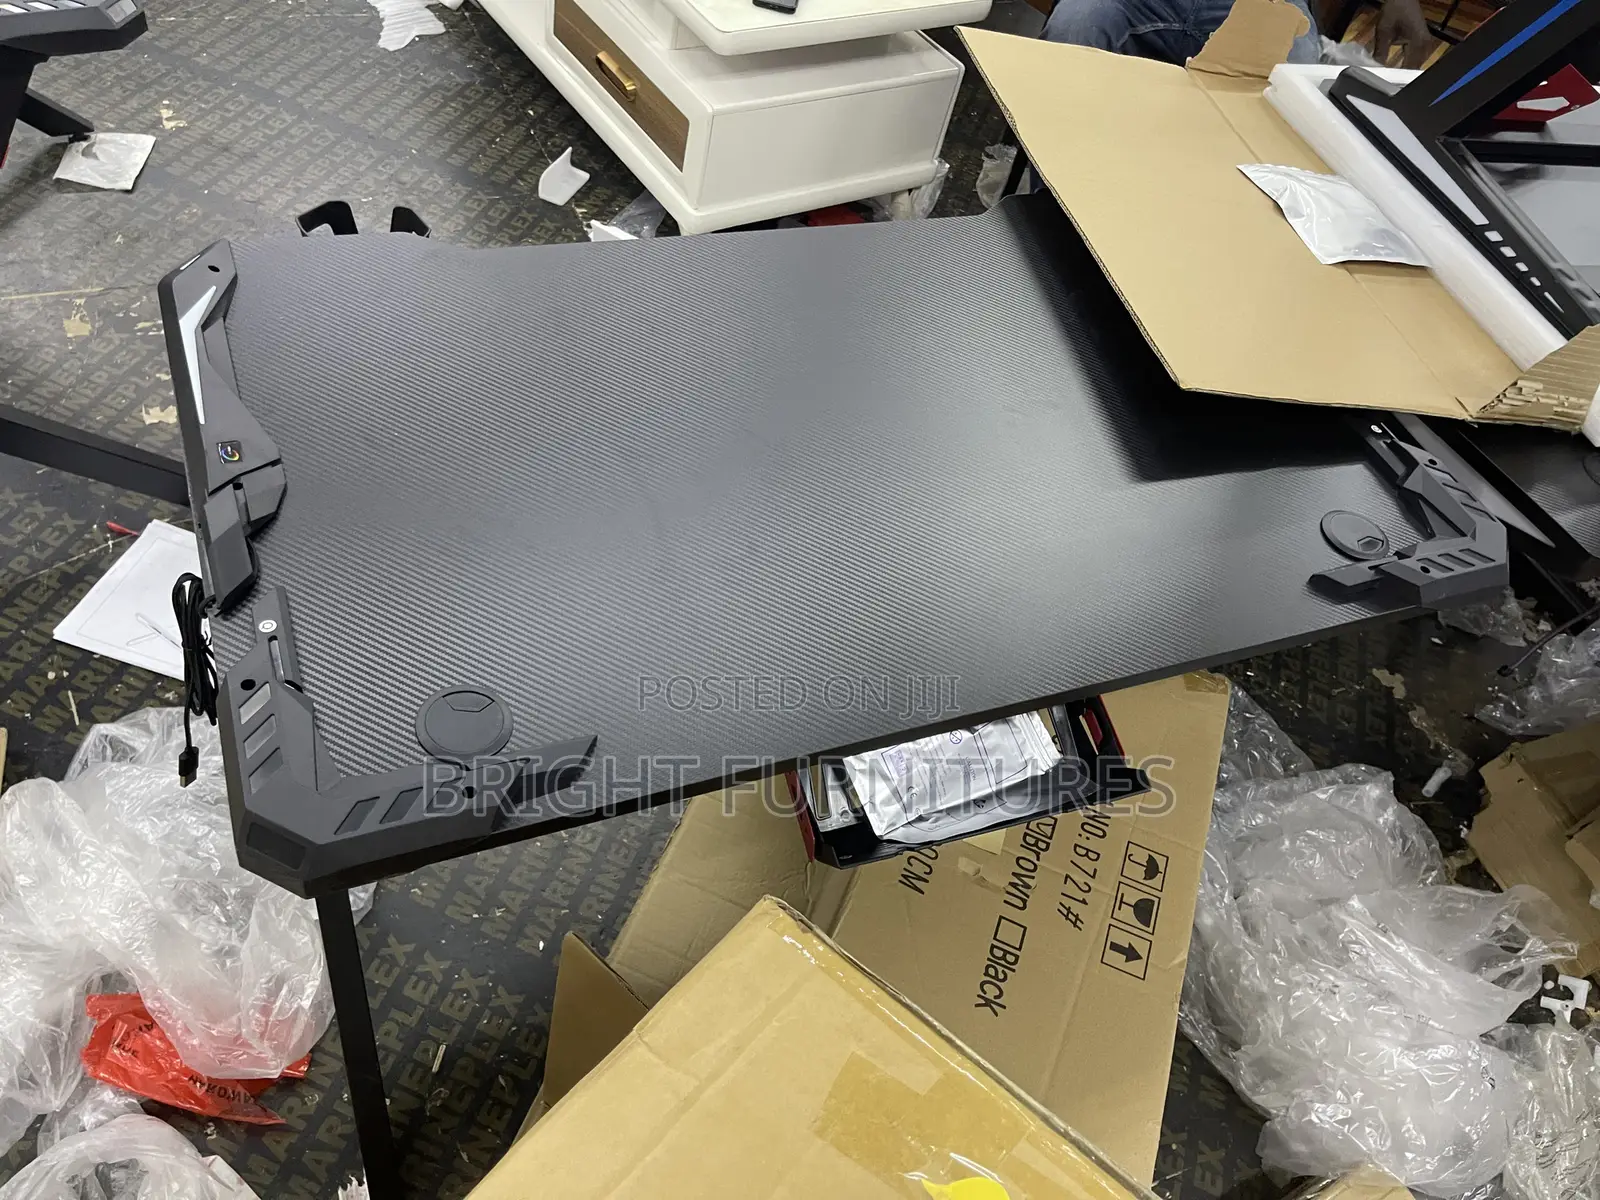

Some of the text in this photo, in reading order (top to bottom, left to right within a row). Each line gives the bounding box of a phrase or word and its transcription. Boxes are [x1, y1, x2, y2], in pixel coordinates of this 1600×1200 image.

[974, 832, 1051, 1017] Brown Black
[1057, 843, 1101, 932] B721#
